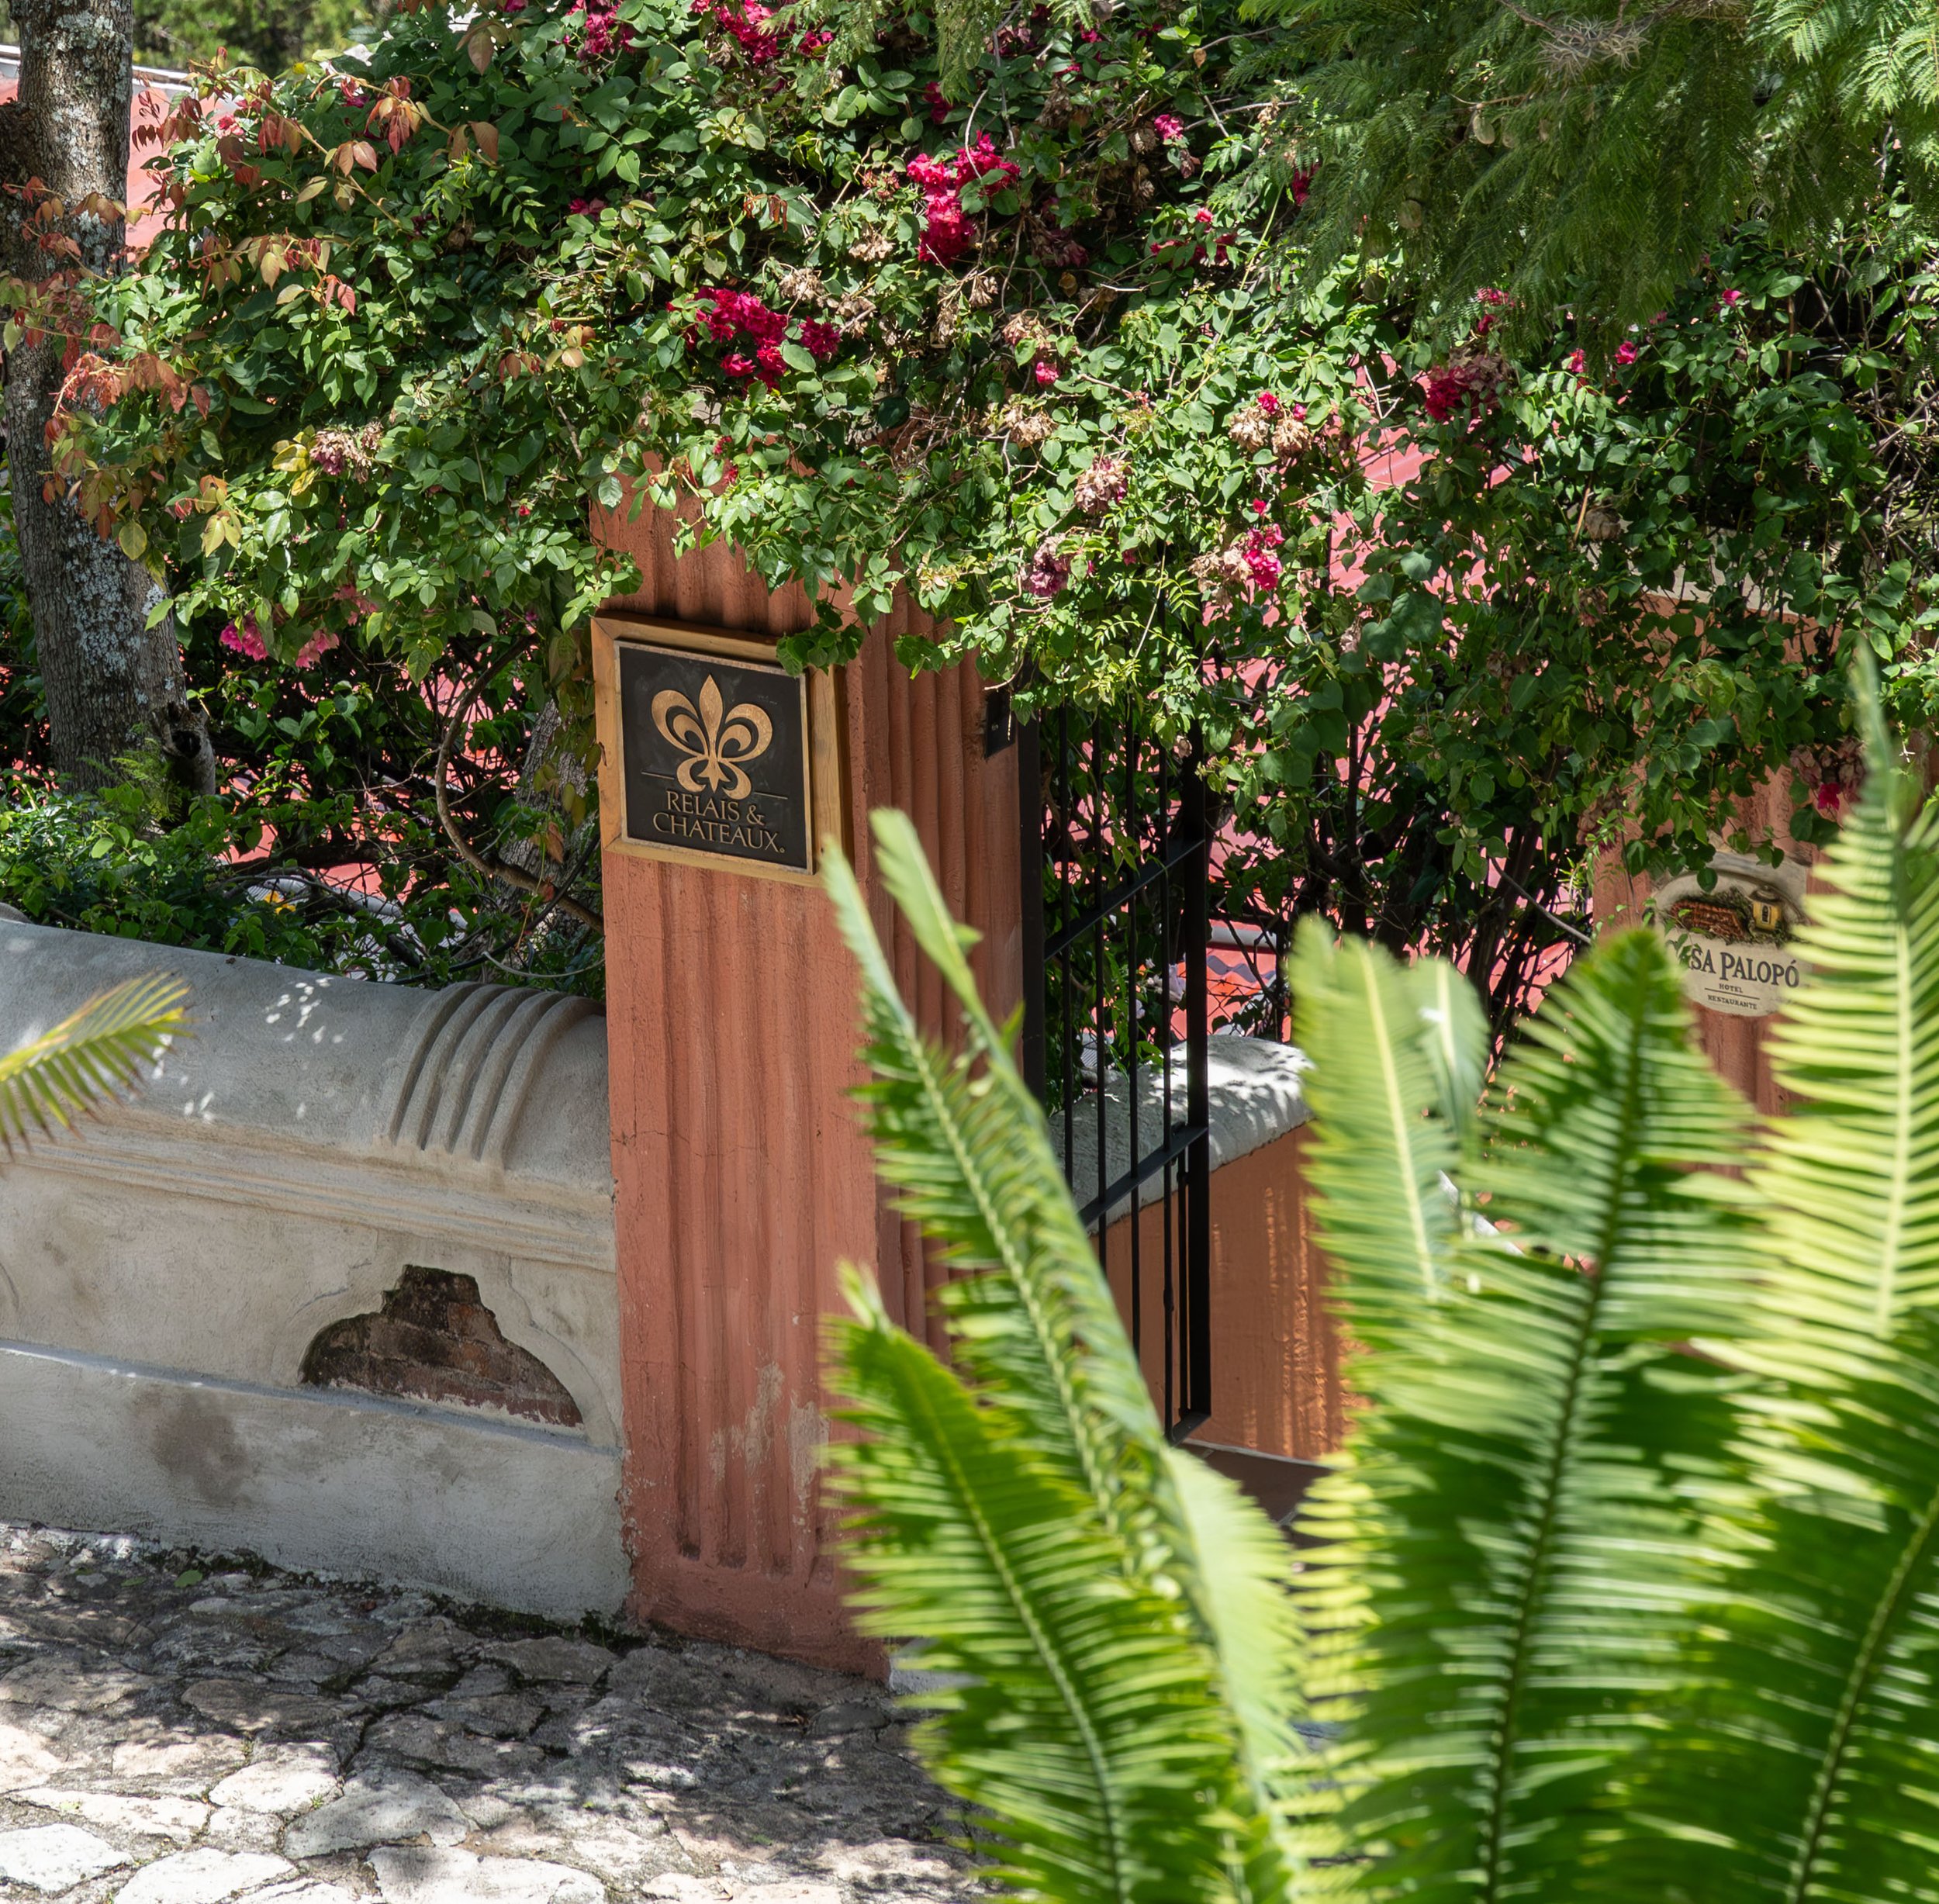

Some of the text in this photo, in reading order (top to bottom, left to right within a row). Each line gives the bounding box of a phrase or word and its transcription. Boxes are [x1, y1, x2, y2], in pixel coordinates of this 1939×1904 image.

[666, 791, 765, 826] RELAIS &
[653, 812, 779, 853] CHATEAUX
[1720, 952, 1799, 988] PALOPÓ
[1708, 995, 1758, 1010] RESTAURANTE
[1719, 983, 1744, 993] HOTEL
